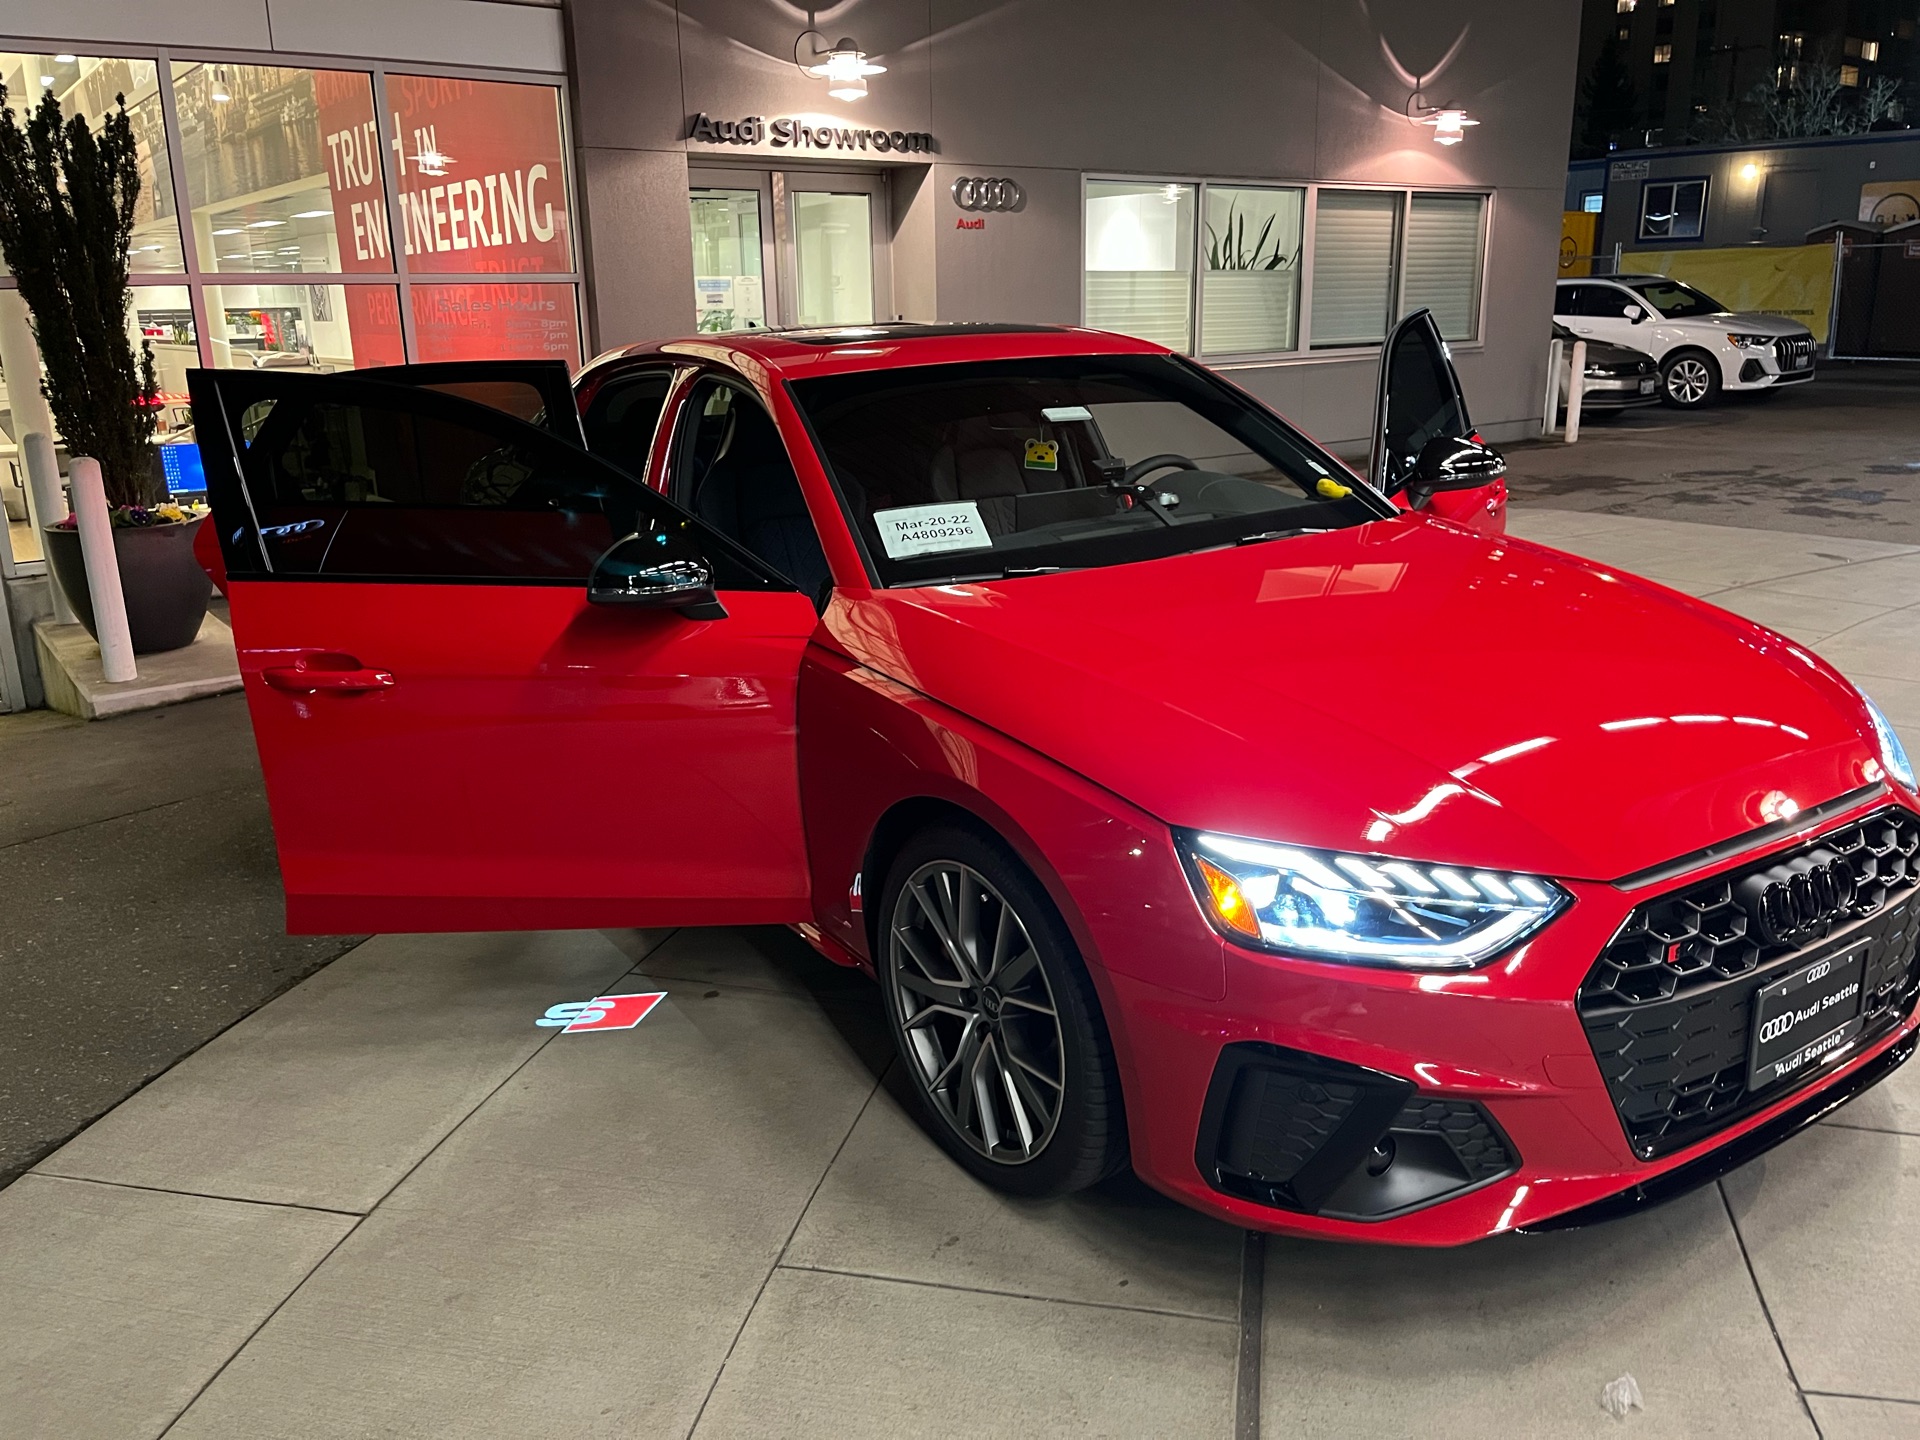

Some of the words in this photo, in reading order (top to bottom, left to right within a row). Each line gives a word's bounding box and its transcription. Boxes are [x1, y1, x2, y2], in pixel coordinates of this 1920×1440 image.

[692, 112, 766, 144] Audi
[770, 118, 937, 155] Showroom
[414, 125, 440, 174] IN
[956, 217, 985, 230] Audi
[367, 287, 476, 326] PERRMANCE
[438, 298, 492, 312] Sales
[497, 298, 555, 312] Hours
[541, 319, 568, 330] 8pm
[543, 331, 569, 341] 7pm
[543, 343, 569, 352] 6pm
[895, 515, 969, 531] Mar-20-22
[901, 527, 974, 542] A4809296
[1794, 1000, 1820, 1025] Audi
[1822, 982, 1859, 1010] Seattle
[1776, 1053, 1802, 1077] Audi
[1804, 1034, 1841, 1062] Seattle
